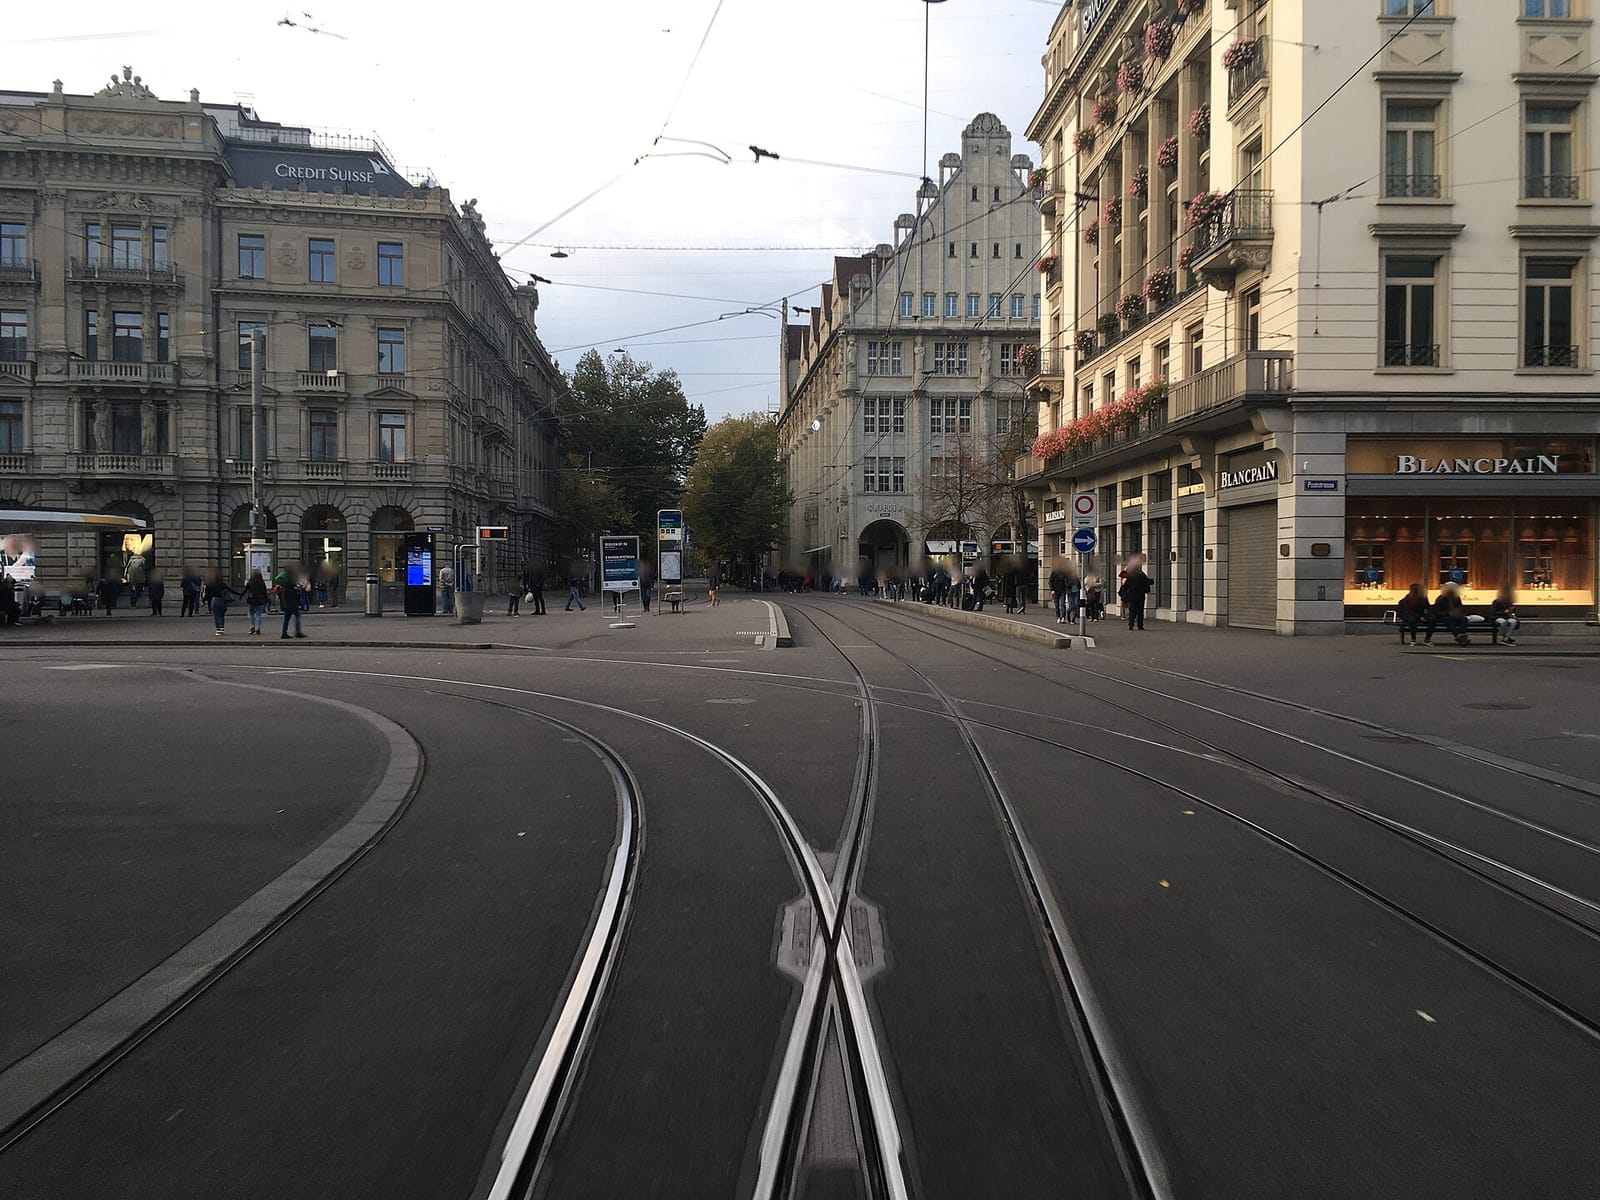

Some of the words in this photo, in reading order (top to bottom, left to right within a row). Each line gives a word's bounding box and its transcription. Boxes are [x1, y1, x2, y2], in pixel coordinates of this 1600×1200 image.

[275, 163, 328, 180] CREDIT
[329, 167, 374, 183] SUISSE
[1221, 461, 1276, 488] BLANCPAIN
[1397, 455, 1560, 474] BLANCPAIN
